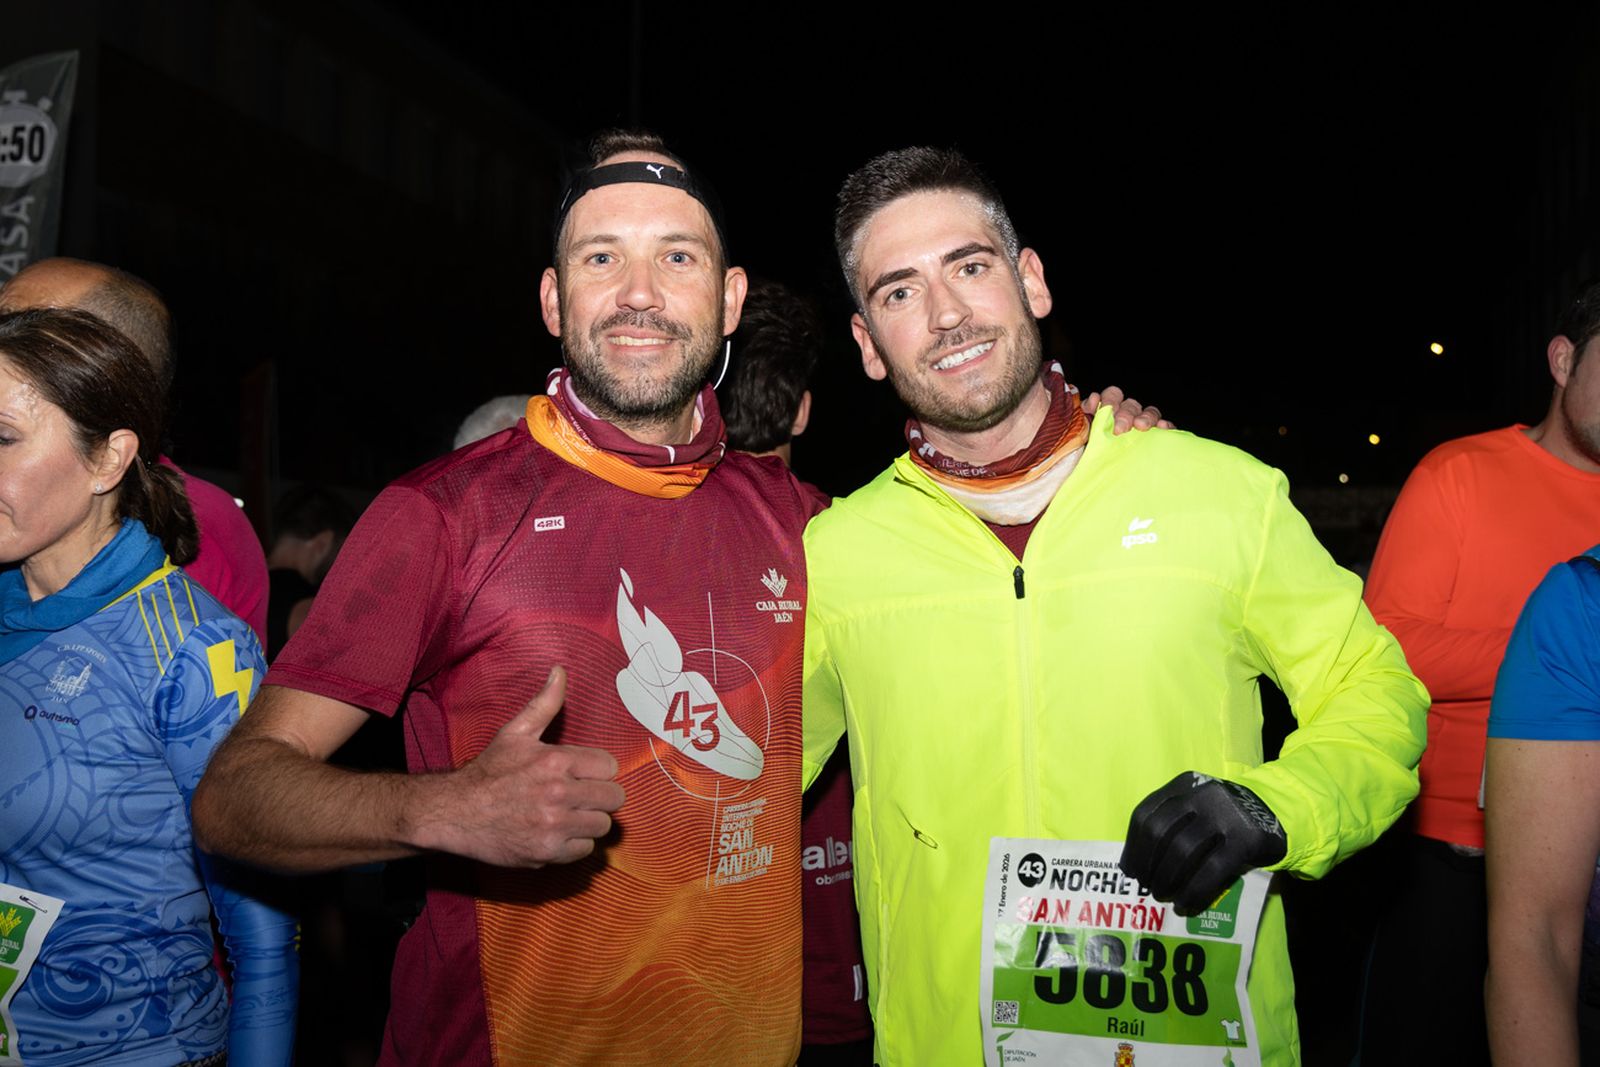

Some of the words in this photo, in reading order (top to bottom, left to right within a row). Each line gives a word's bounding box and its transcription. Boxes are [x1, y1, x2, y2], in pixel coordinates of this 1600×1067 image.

[537, 518, 563, 529] 42K
[778, 600, 802, 611] RURAL
[773, 612, 793, 624] JAÉN
[664, 690, 720, 752] 43
[717, 829, 754, 855] SAN
[1002, 853, 1011, 873] 2026
[1018, 860, 1045, 879] 43
[1051, 858, 1083, 868] CARRERA
[1084, 859, 1113, 870] URBANA
[1000, 874, 1008, 884] de
[1050, 868, 1131, 896] NOCHE
[1016, 896, 1071, 924] SAN
[1077, 898, 1166, 933] ANTÓN
[1200, 919, 1219, 929] JAÉN
[1208, 911, 1232, 922] RURAL
[1033, 931, 1209, 1017] 5838
[1107, 1017, 1144, 1036] Raúl
